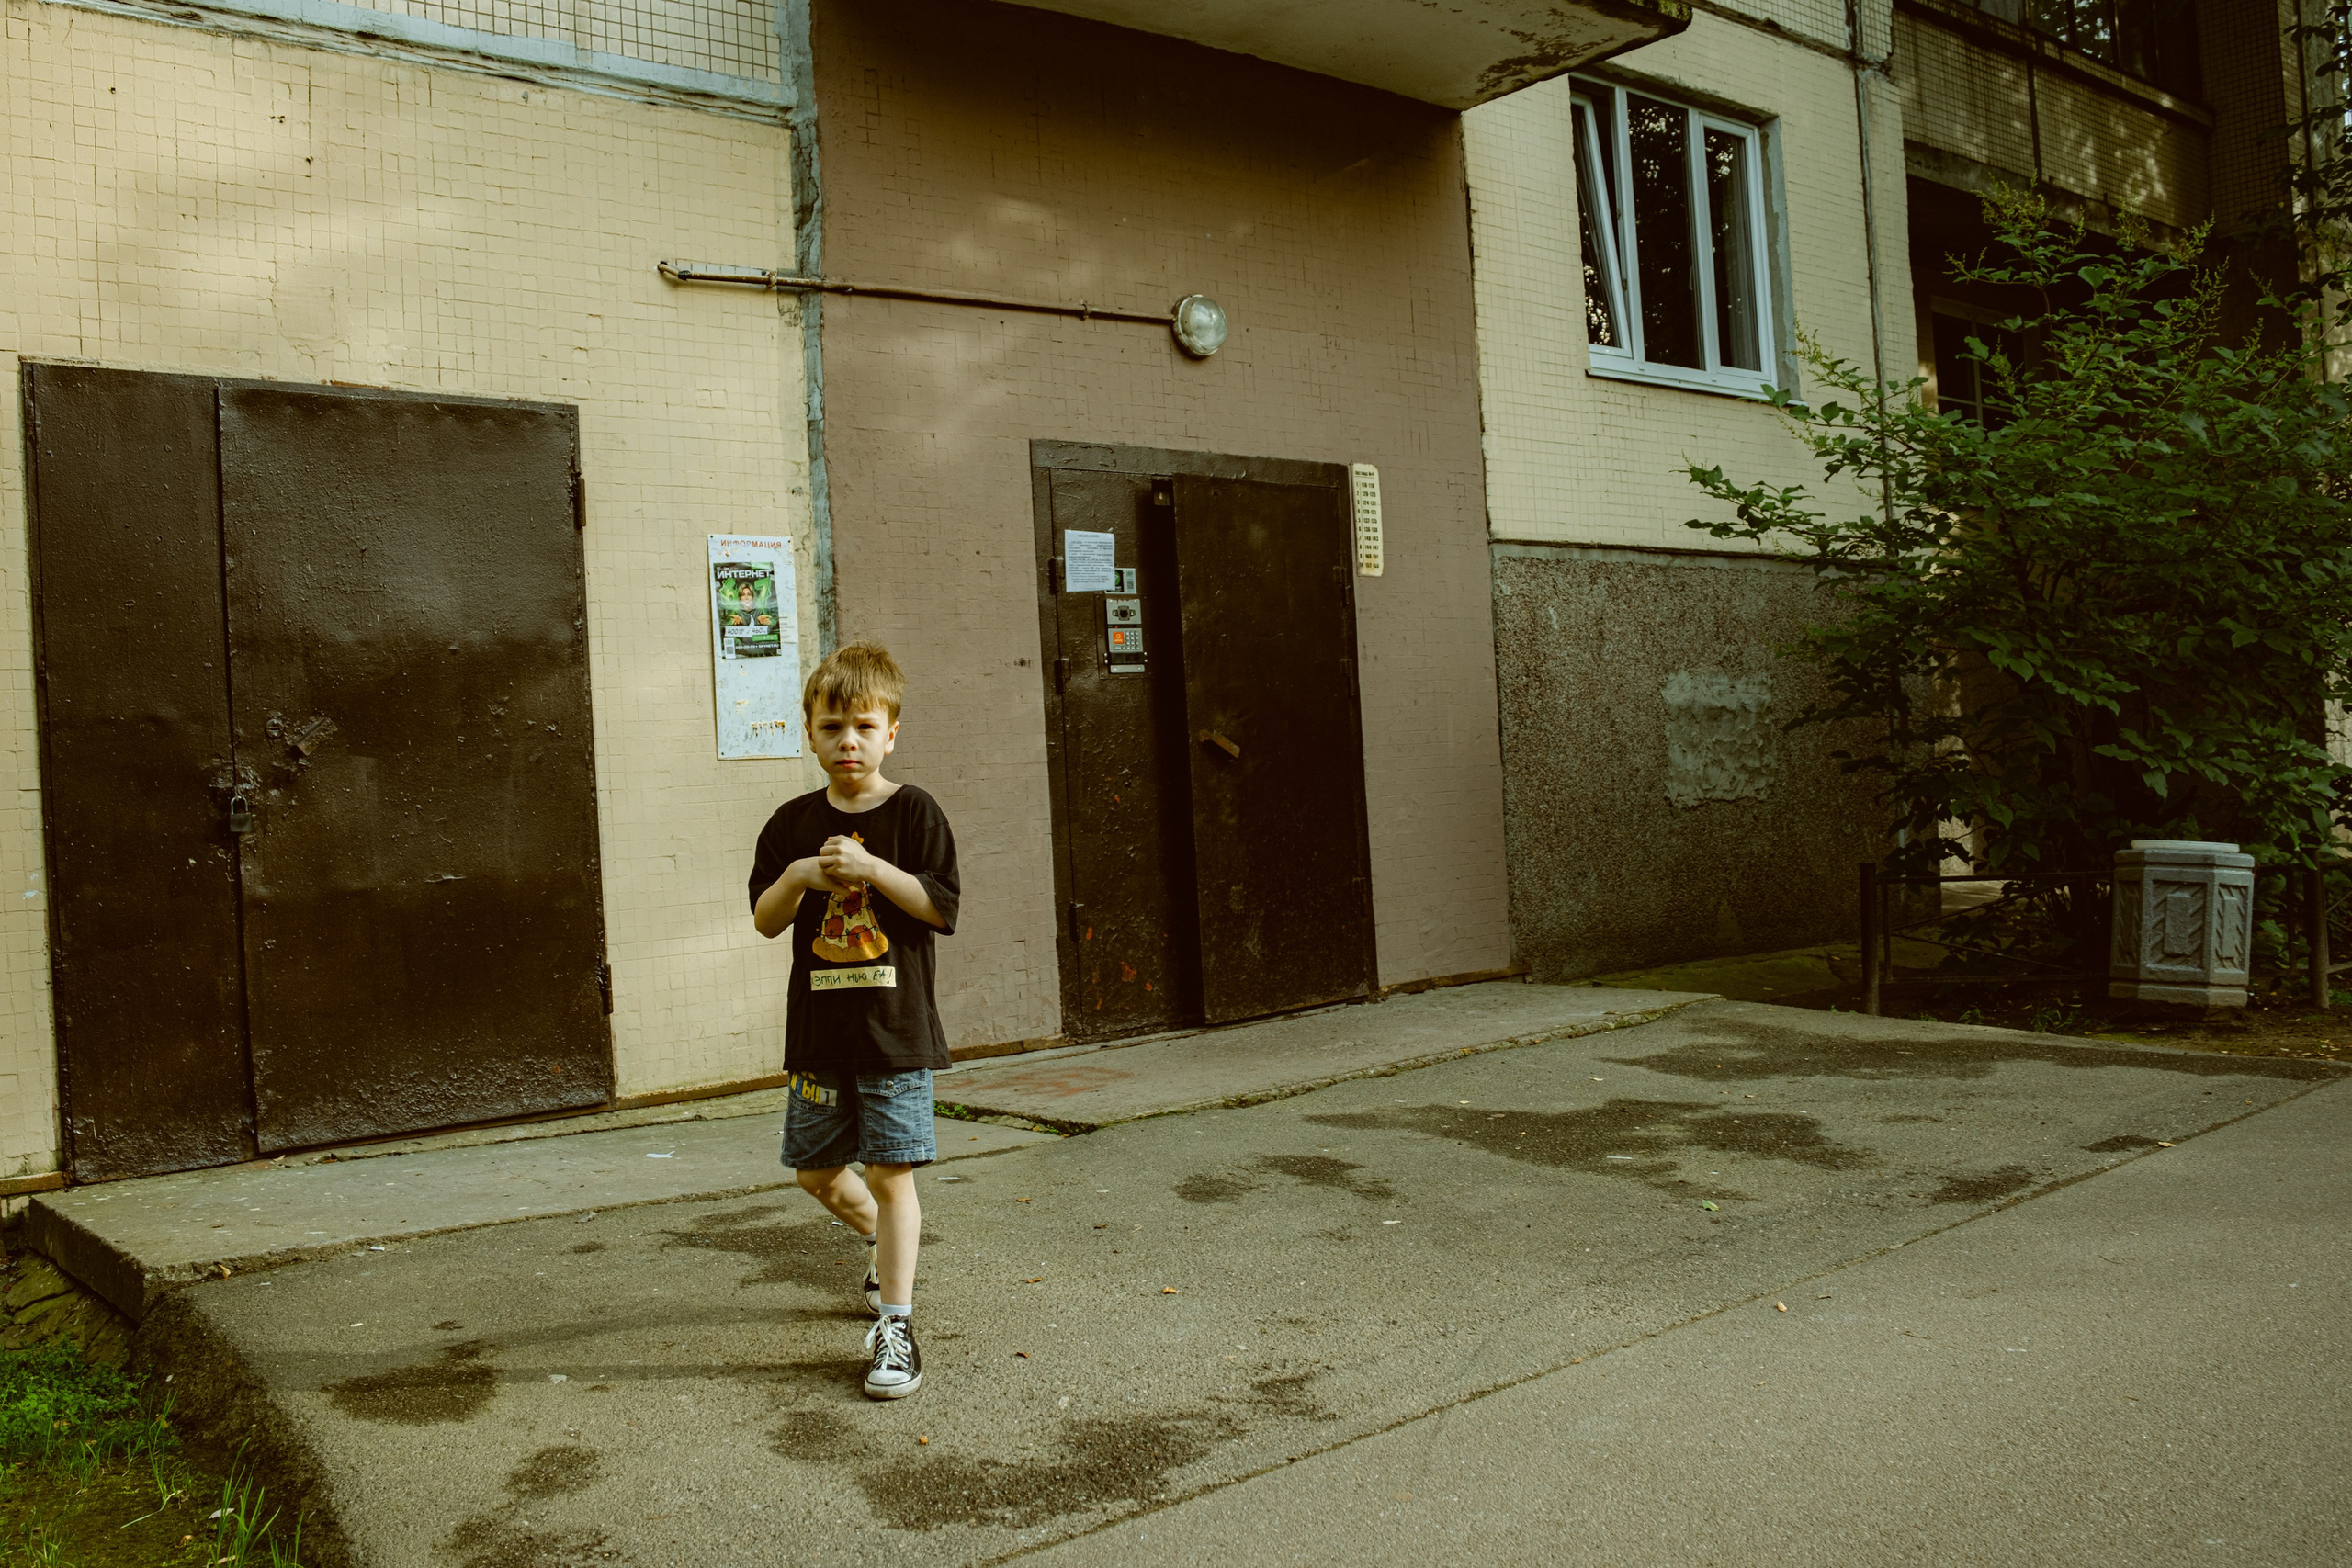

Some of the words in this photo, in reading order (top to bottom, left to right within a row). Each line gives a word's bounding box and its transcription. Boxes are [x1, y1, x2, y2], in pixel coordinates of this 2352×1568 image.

[720, 539, 782, 548] ИНФОРМАЦИЯ
[717, 570, 771, 579] ИНТЕРНЕТ
[846, 972, 868, 984] НЬЮ
